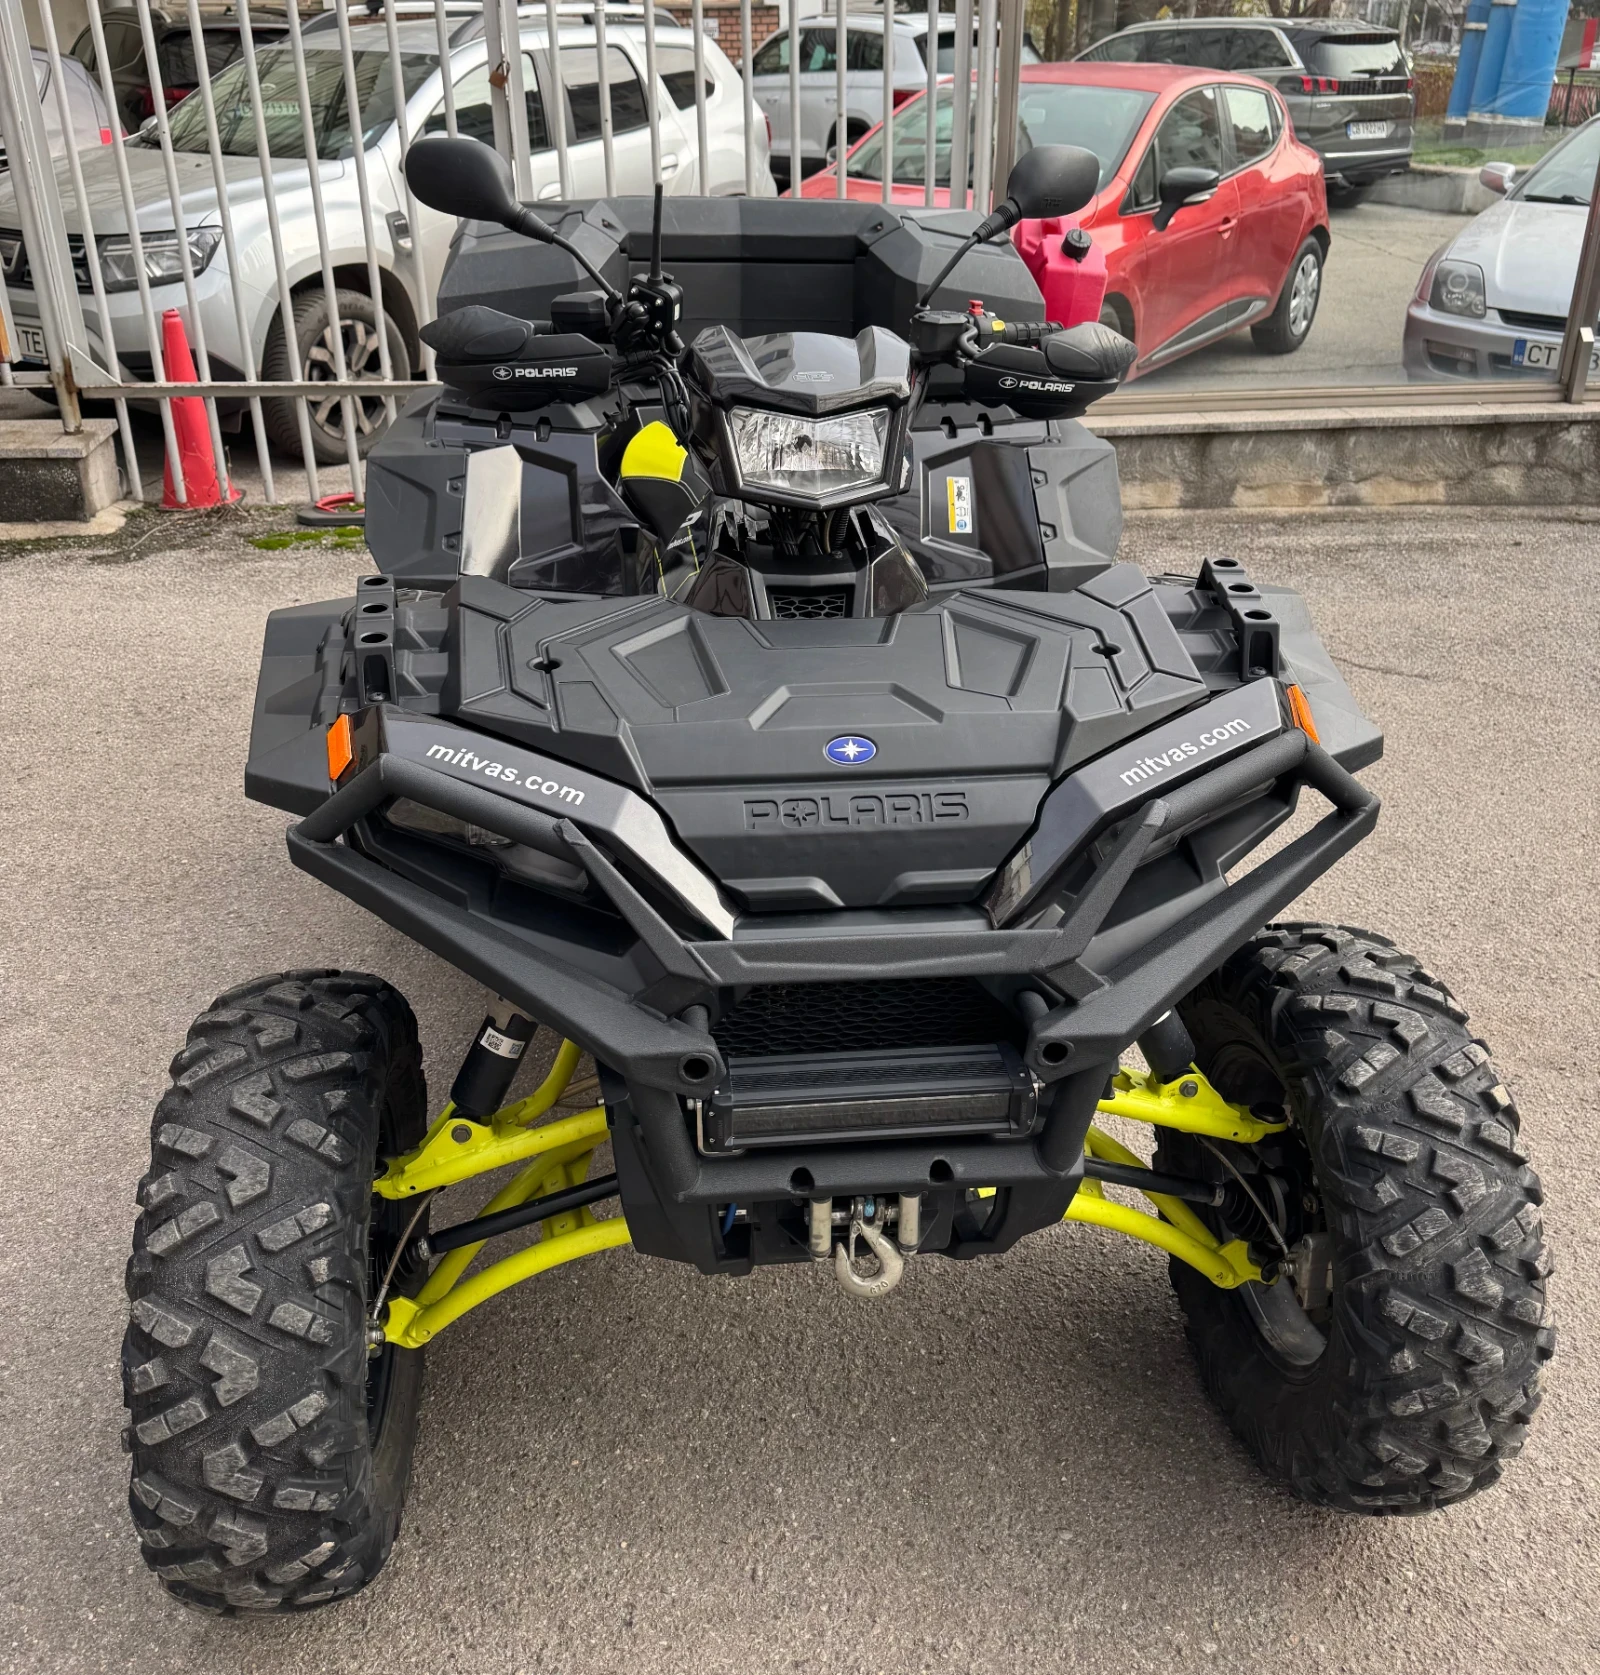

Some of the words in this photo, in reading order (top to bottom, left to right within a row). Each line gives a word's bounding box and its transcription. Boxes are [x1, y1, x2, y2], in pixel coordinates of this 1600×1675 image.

[1527, 345, 1557, 366] CT
[515, 367, 578, 378] POLARIS
[1018, 380, 1075, 393] POLARIS
[1119, 717, 1252, 787] mitvas.com
[425, 744, 587, 806] mitvas.com
[743, 792, 970, 831] POLARIS
